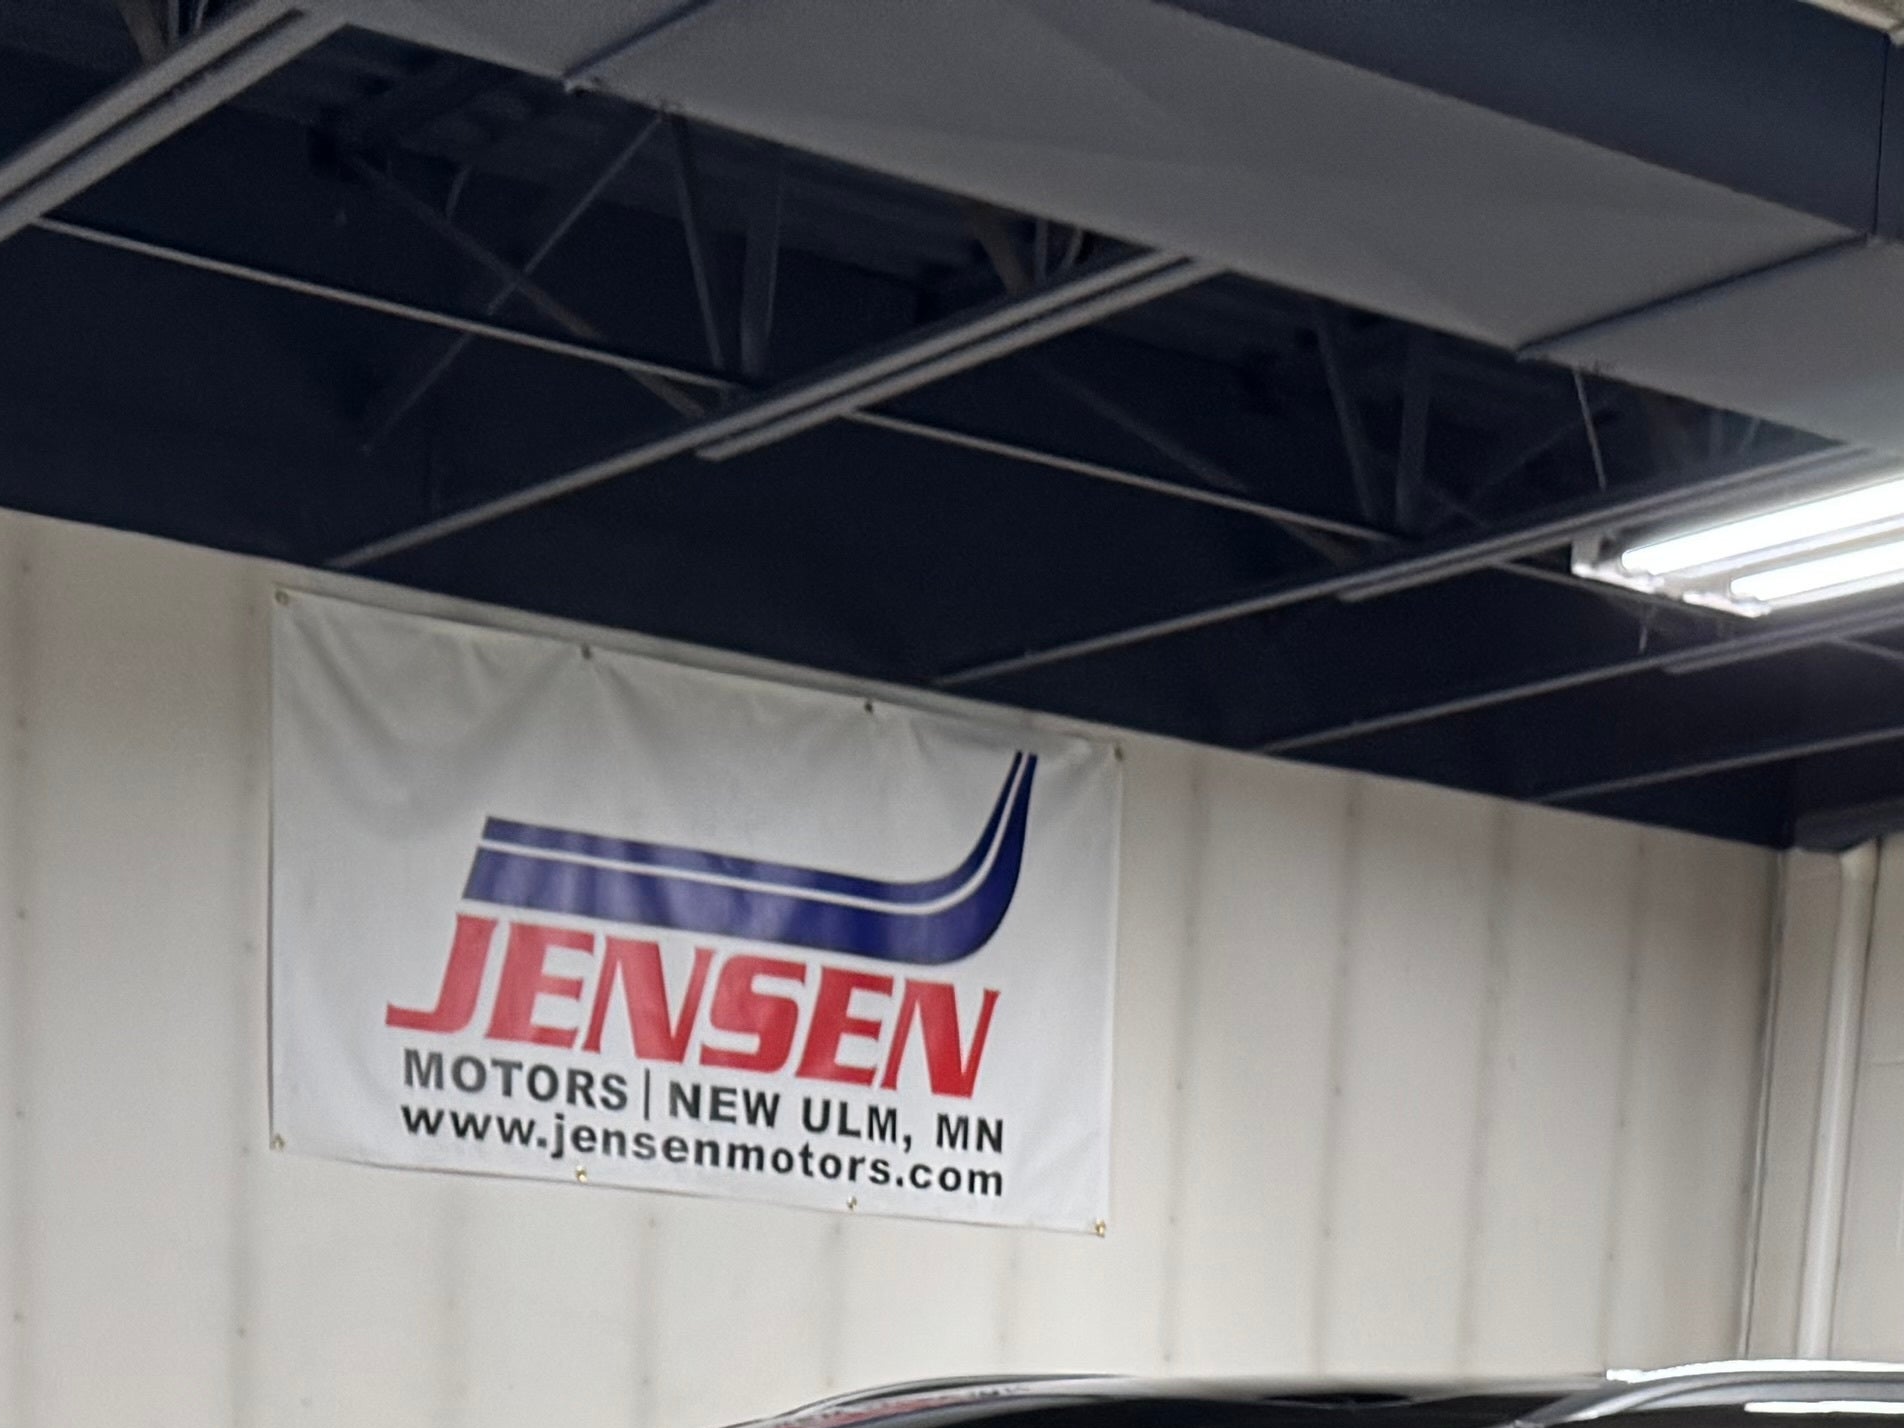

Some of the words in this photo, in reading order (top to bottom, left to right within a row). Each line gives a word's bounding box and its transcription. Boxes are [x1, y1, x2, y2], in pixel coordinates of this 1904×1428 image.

[384, 912, 1002, 1100] JENSEN
[400, 1103, 1004, 1198] www.jensenmotors.com
[403, 1047, 628, 1111] MOTORS
[668, 1079, 780, 1129] NEW
[802, 1096, 912, 1153] ULM,
[936, 1112, 1004, 1155] MN
